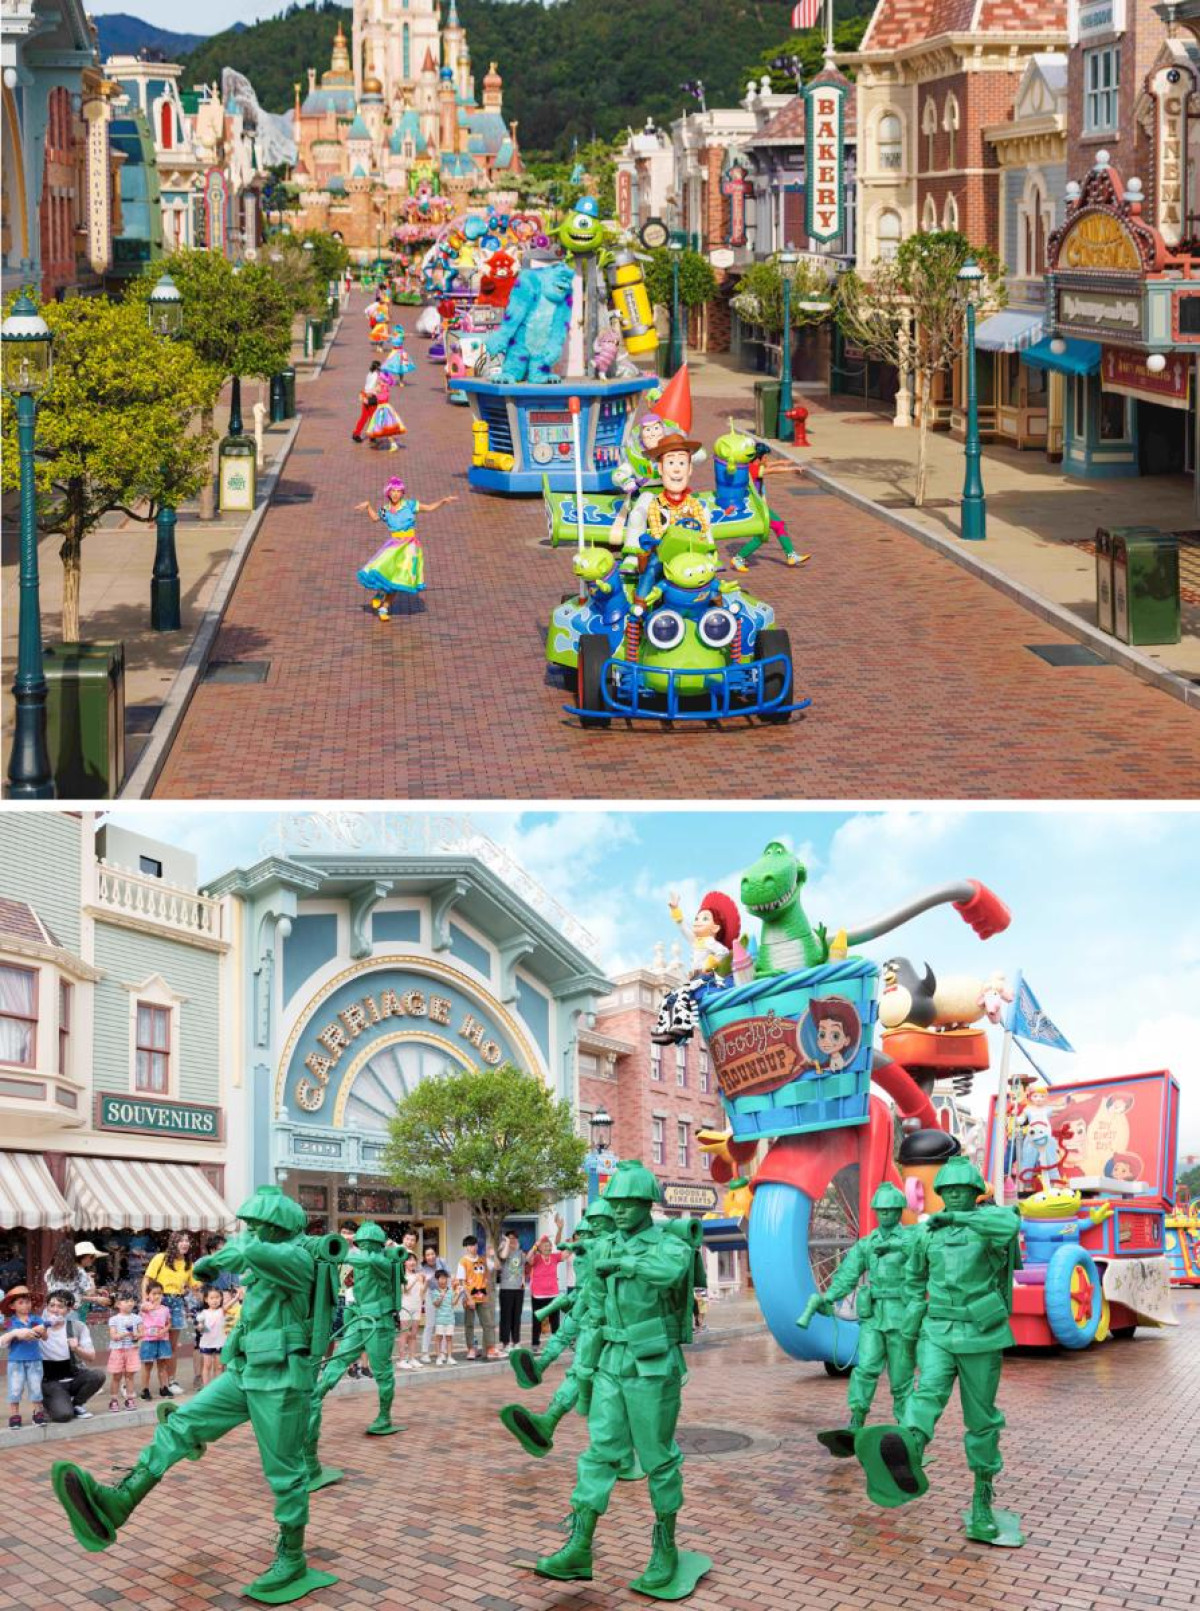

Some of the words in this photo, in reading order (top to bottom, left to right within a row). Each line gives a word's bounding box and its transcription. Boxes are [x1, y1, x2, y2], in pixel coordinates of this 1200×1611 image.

[816, 98, 838, 230] BAKERY
[1161, 97, 1182, 224] CINEMA
[296, 990, 452, 1113] CARRIAGE
[459, 1014, 508, 1072] HO
[720, 1049, 786, 1091] ROUNDUP
[106, 1101, 215, 1133] SOUVENIRS
